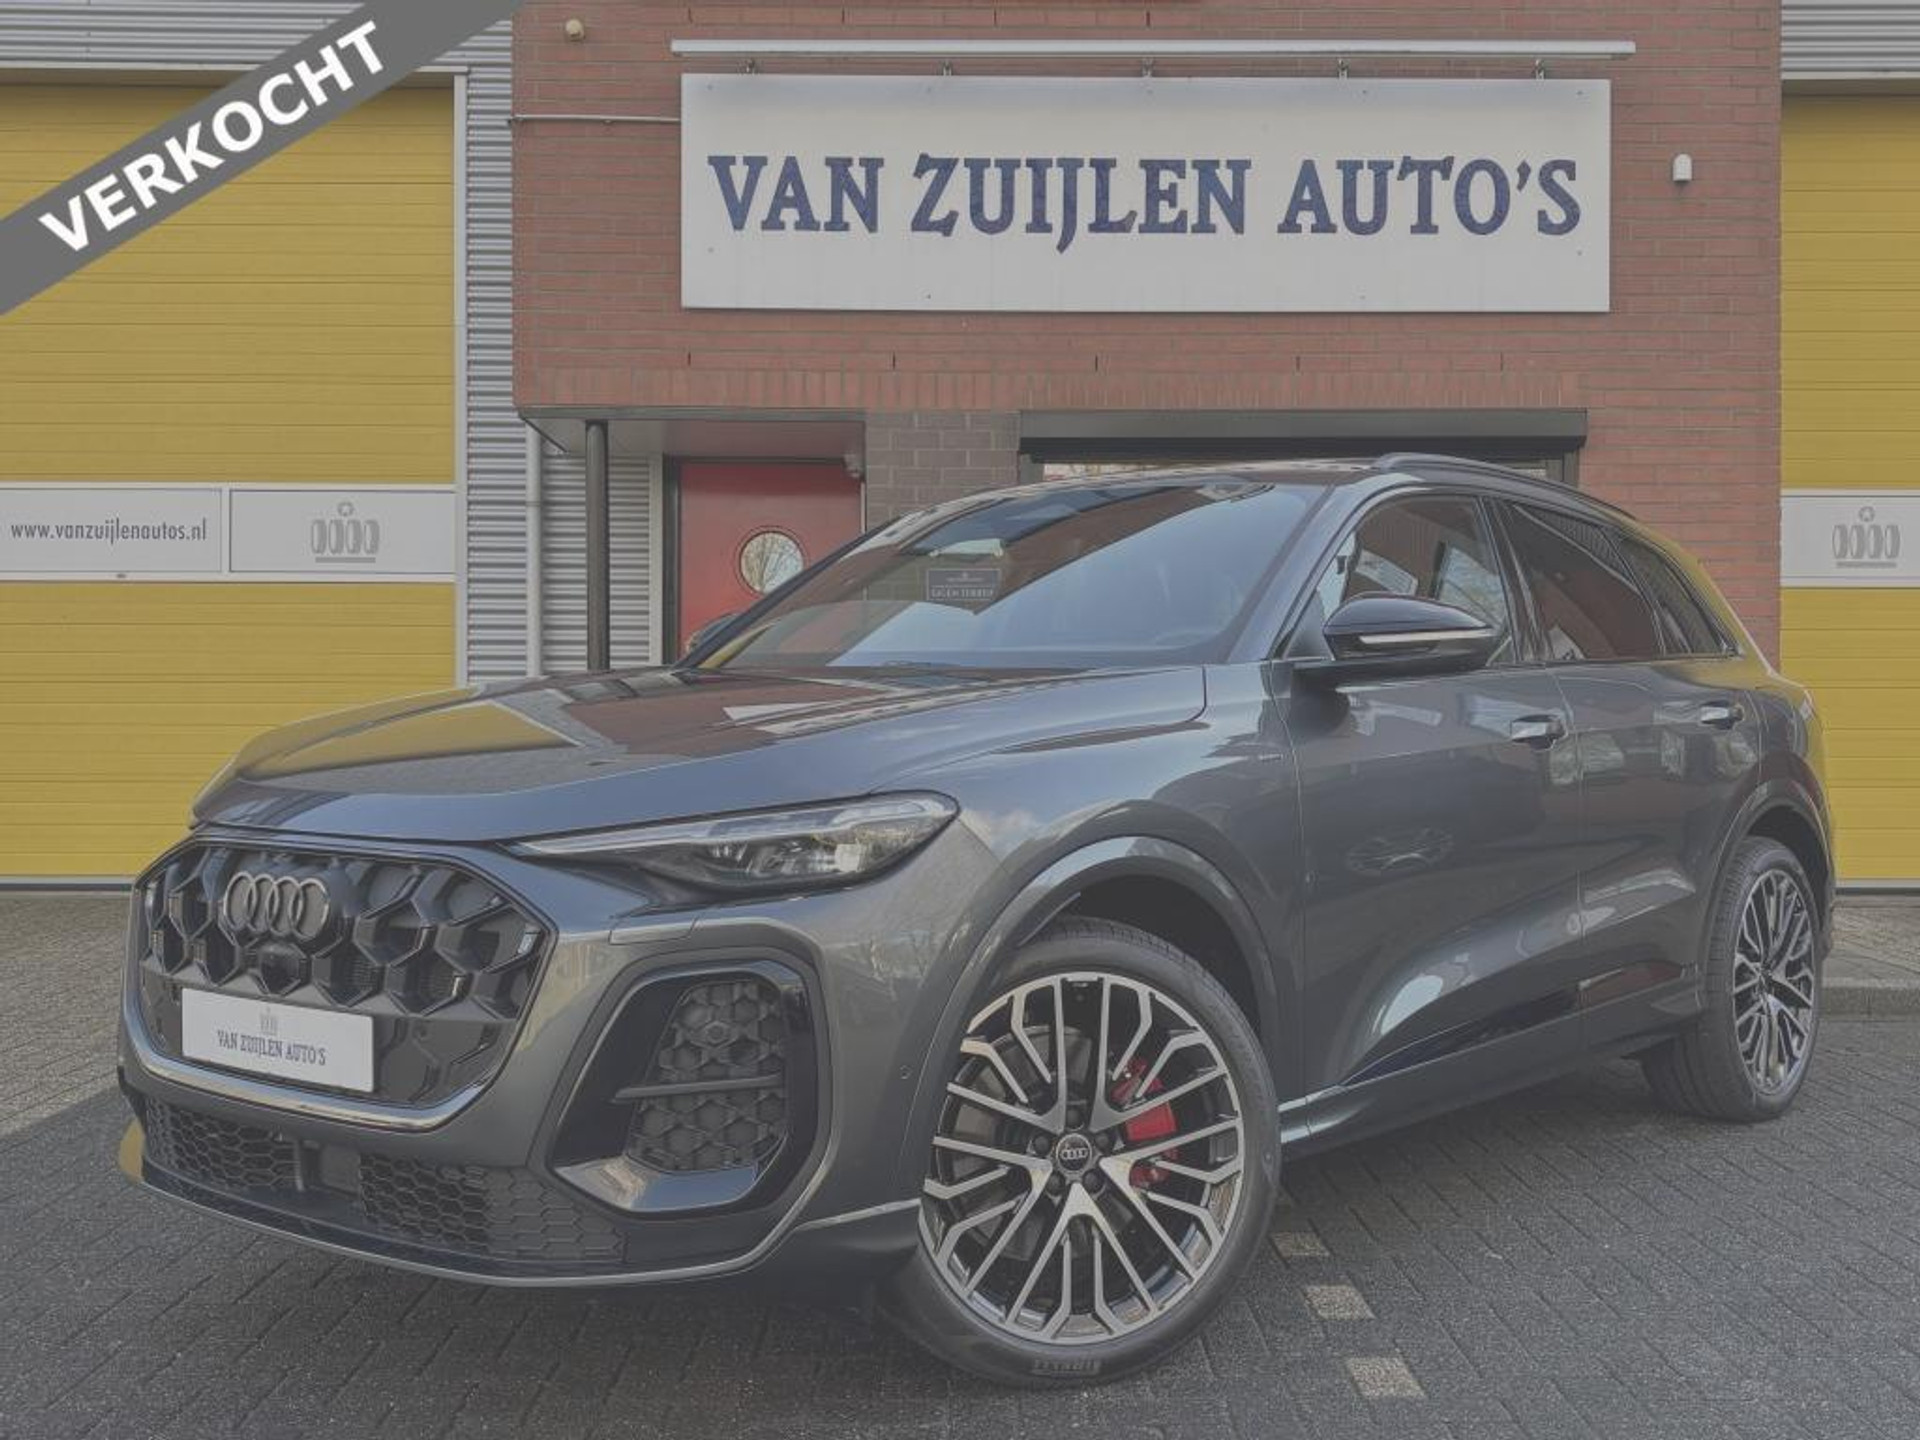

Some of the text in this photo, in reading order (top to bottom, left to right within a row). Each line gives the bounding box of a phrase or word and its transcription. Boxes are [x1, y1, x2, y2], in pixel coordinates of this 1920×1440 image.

[707, 153, 1581, 254] VAN ZUIJLEN AUTO'S
[11, 517, 207, 545] www.vanzuijlenautos.nl
[217, 1029, 238, 1050] VAN
